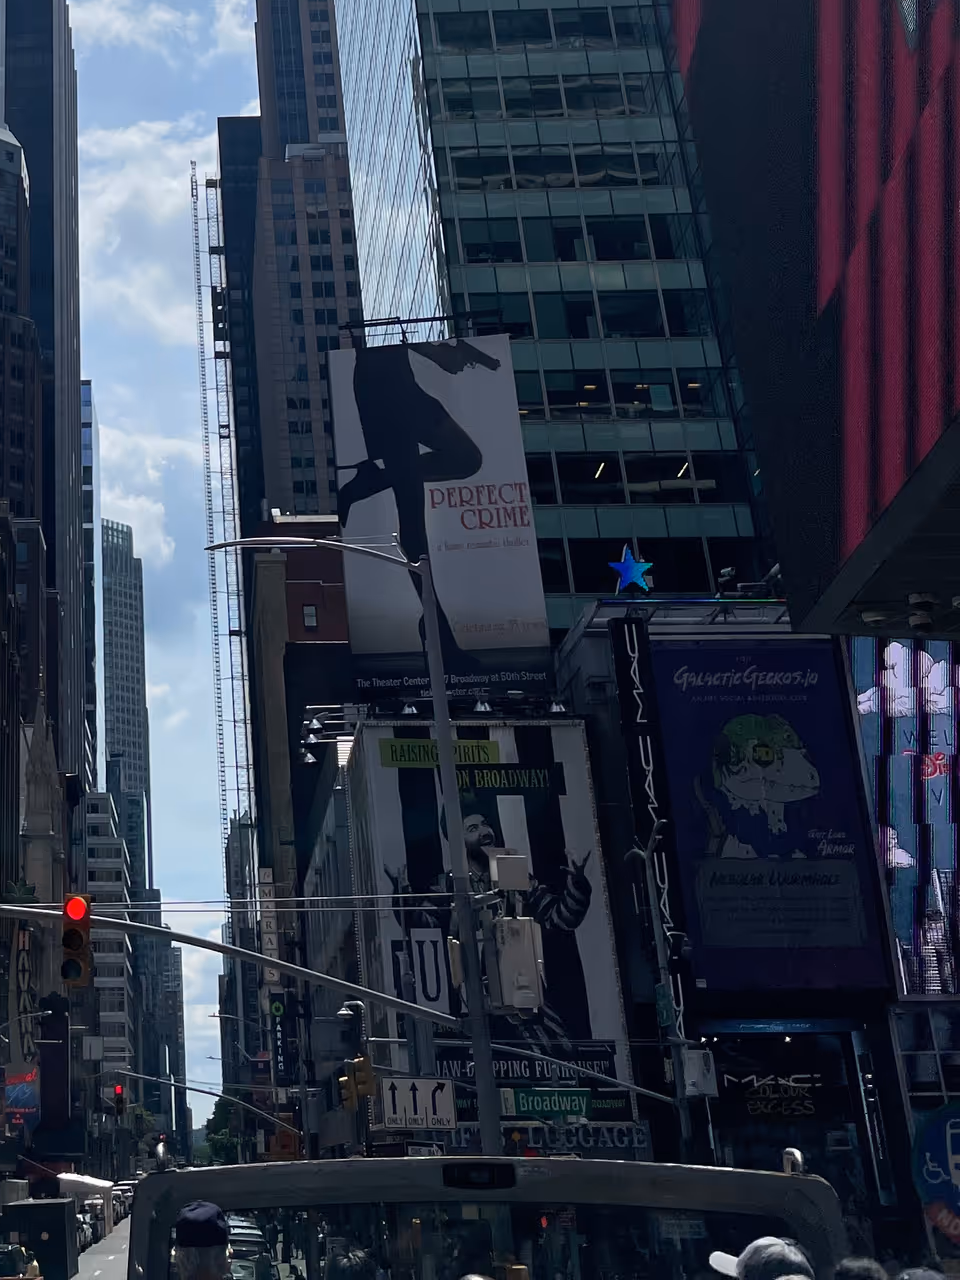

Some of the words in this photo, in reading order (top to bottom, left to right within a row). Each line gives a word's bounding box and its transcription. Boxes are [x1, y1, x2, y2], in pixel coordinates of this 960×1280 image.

[429, 482, 528, 509] PERFECT
[460, 505, 531, 530] CRIME
[357, 678, 371, 688] The
[372, 676, 402, 688] Theater
[403, 676, 430, 686] Center
[450, 674, 490, 684] Broadway
[521, 671, 547, 681] Street
[390, 743, 440, 762] RAISING
[475, 769, 550, 788] BROADWAY!
[275, 1016, 284, 1071] PARKING
[520, 1091, 587, 1117] Broadway
[432, 1118, 450, 1126] ONLY
[527, 1125, 647, 1148] LUGGAGE
